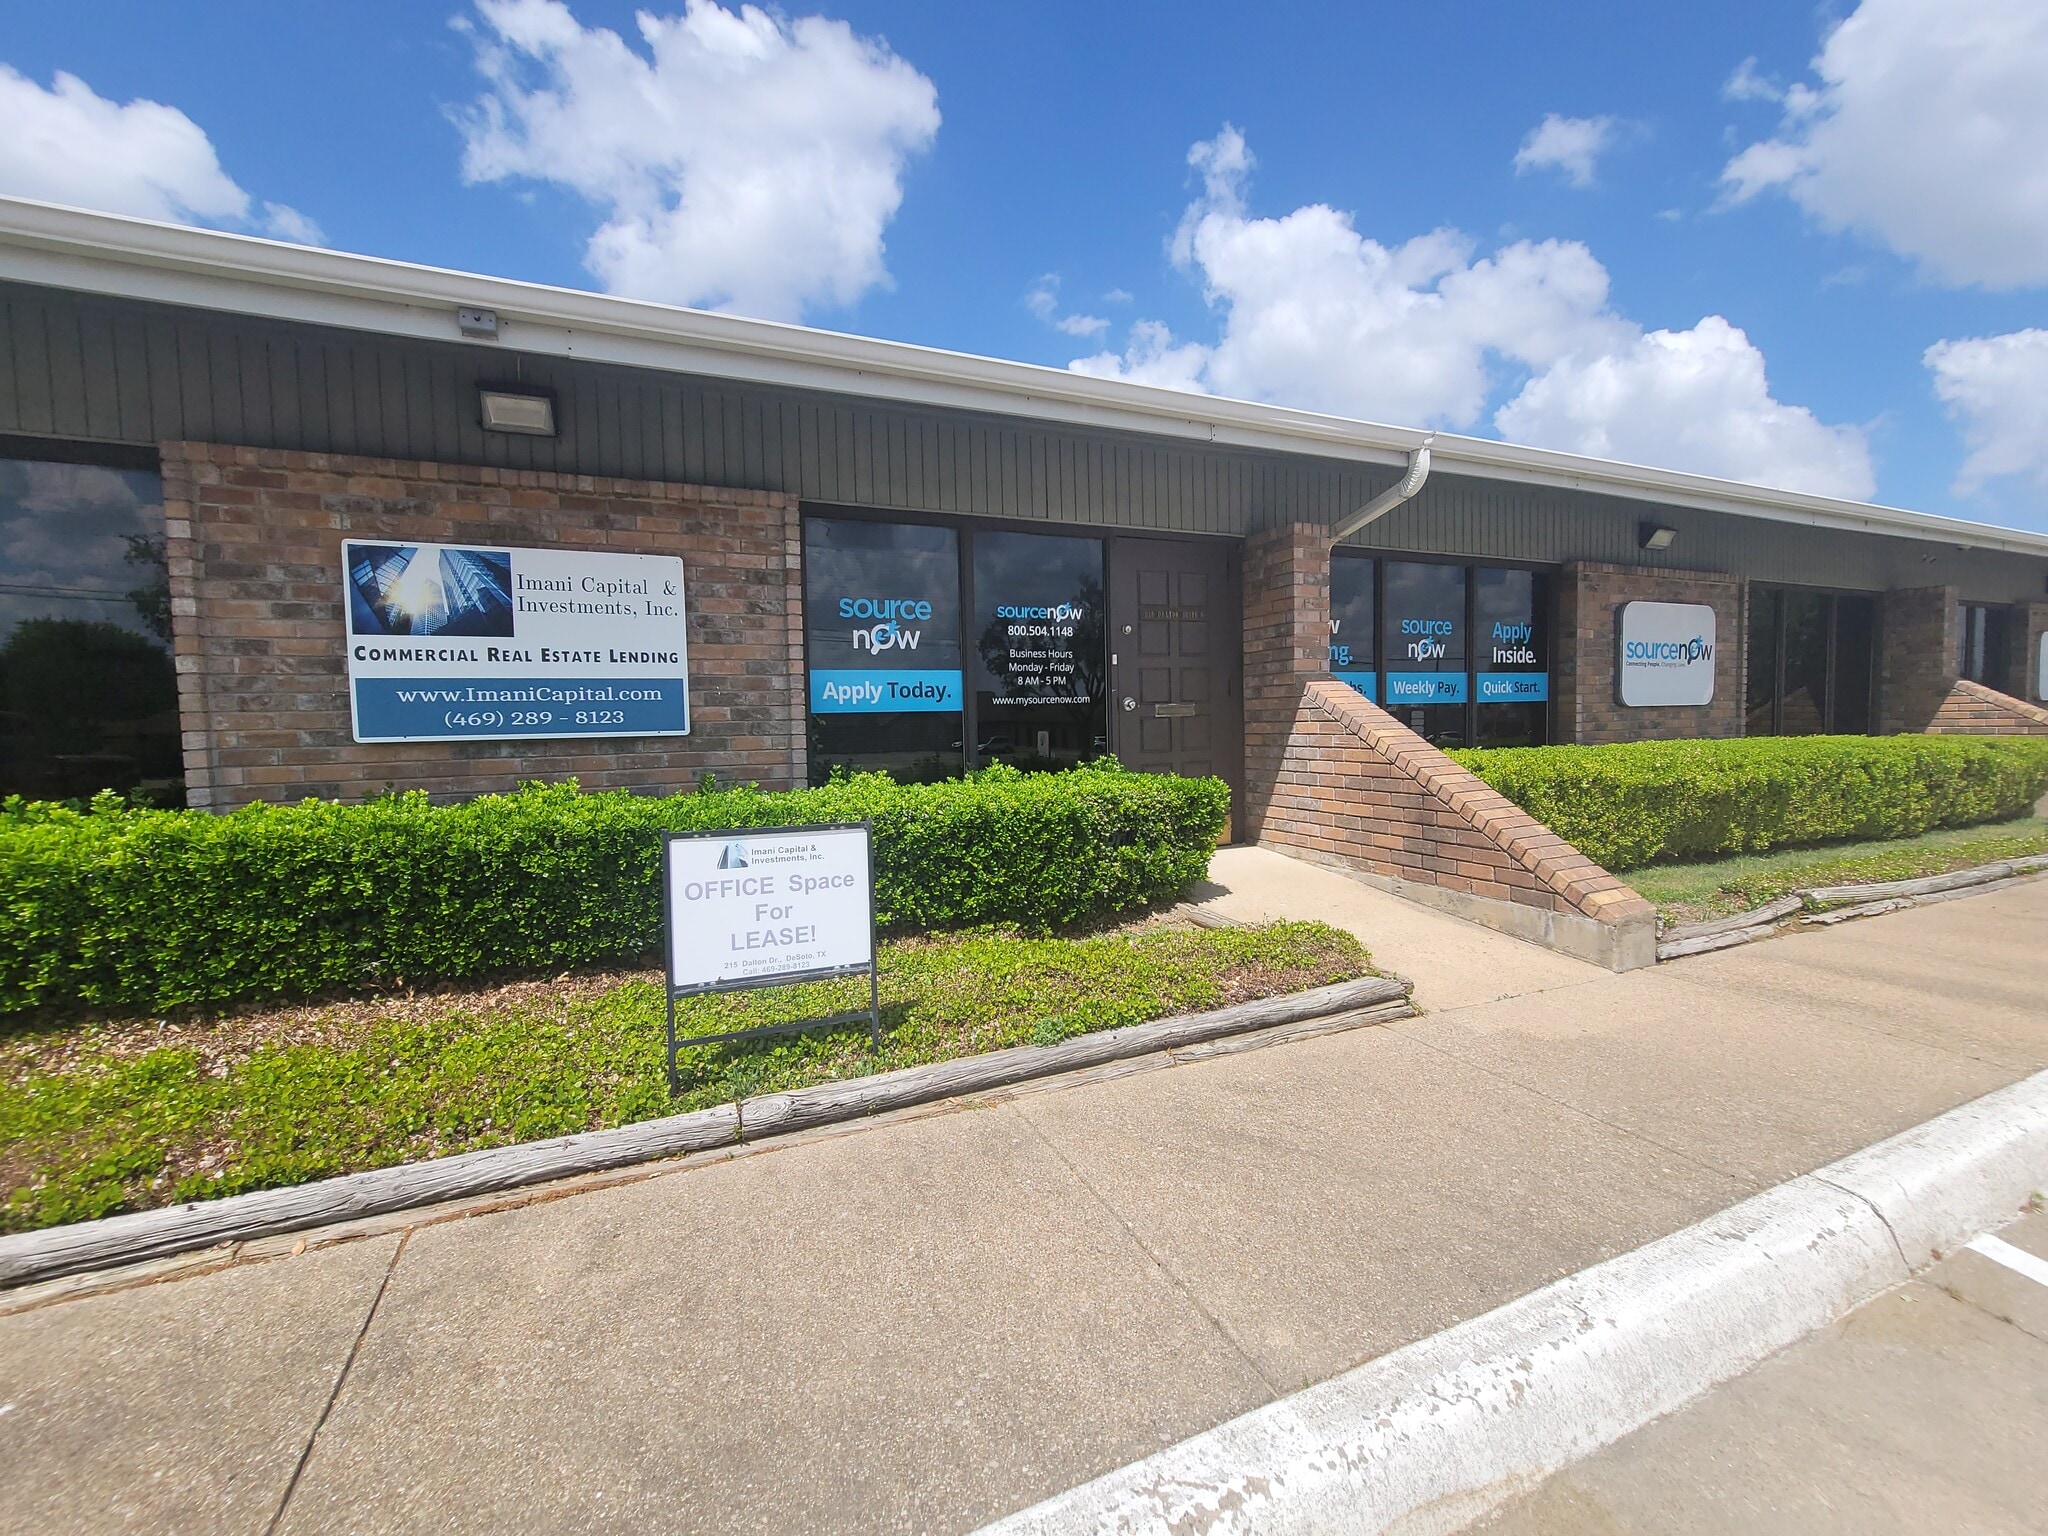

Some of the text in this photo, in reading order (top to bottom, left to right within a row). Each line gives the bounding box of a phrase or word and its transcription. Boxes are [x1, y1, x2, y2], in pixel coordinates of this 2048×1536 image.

[517, 574, 677, 598] Imani Capital &
[517, 596, 678, 618] Investments, Inc.
[839, 598, 932, 620] source
[997, 604, 1082, 622] sourcenow
[1007, 625, 1074, 637] 800.504.1148
[1401, 618, 1452, 636] source
[1492, 622, 1532, 644] Apply
[853, 622, 921, 655] now
[354, 645, 679, 664] COMMERCIAL REAL ESTATE LENDING
[1009, 649, 1073, 659] Business Hours
[1408, 638, 1445, 662] now
[1493, 646, 1537, 664] Inside.
[1626, 638, 1712, 665] sourcenow
[1008, 662, 1043, 674] Monday
[1049, 662, 1074, 674] Friday
[1017, 676, 1023, 685] 8
[1024, 676, 1039, 685] AM
[1046, 676, 1051, 685] 5
[1053, 676, 1066, 685] PM
[1393, 681, 1460, 698] Weekly Pay.
[1483, 681, 1540, 695] Quick Start.
[396, 686, 662, 705] www.ImaniCapital.com
[822, 681, 952, 705] Apply Today.
[992, 696, 1091, 707] www.mysourcenow.com
[444, 710, 503, 729] (469)
[511, 711, 552, 726] 289
[575, 710, 624, 725] 8123
[751, 844, 817, 856] Imani Capital &
[751, 853, 825, 865] Investments, Inc.
[684, 873, 855, 901] OFFICE Space
[755, 903, 793, 922] For
[731, 924, 816, 951] LEASE!
[724, 961, 738, 969] 215
[742, 959, 767, 967] Dalton
[786, 953, 815, 962] DeSoto,
[761, 962, 810, 973] 469-289-8123
